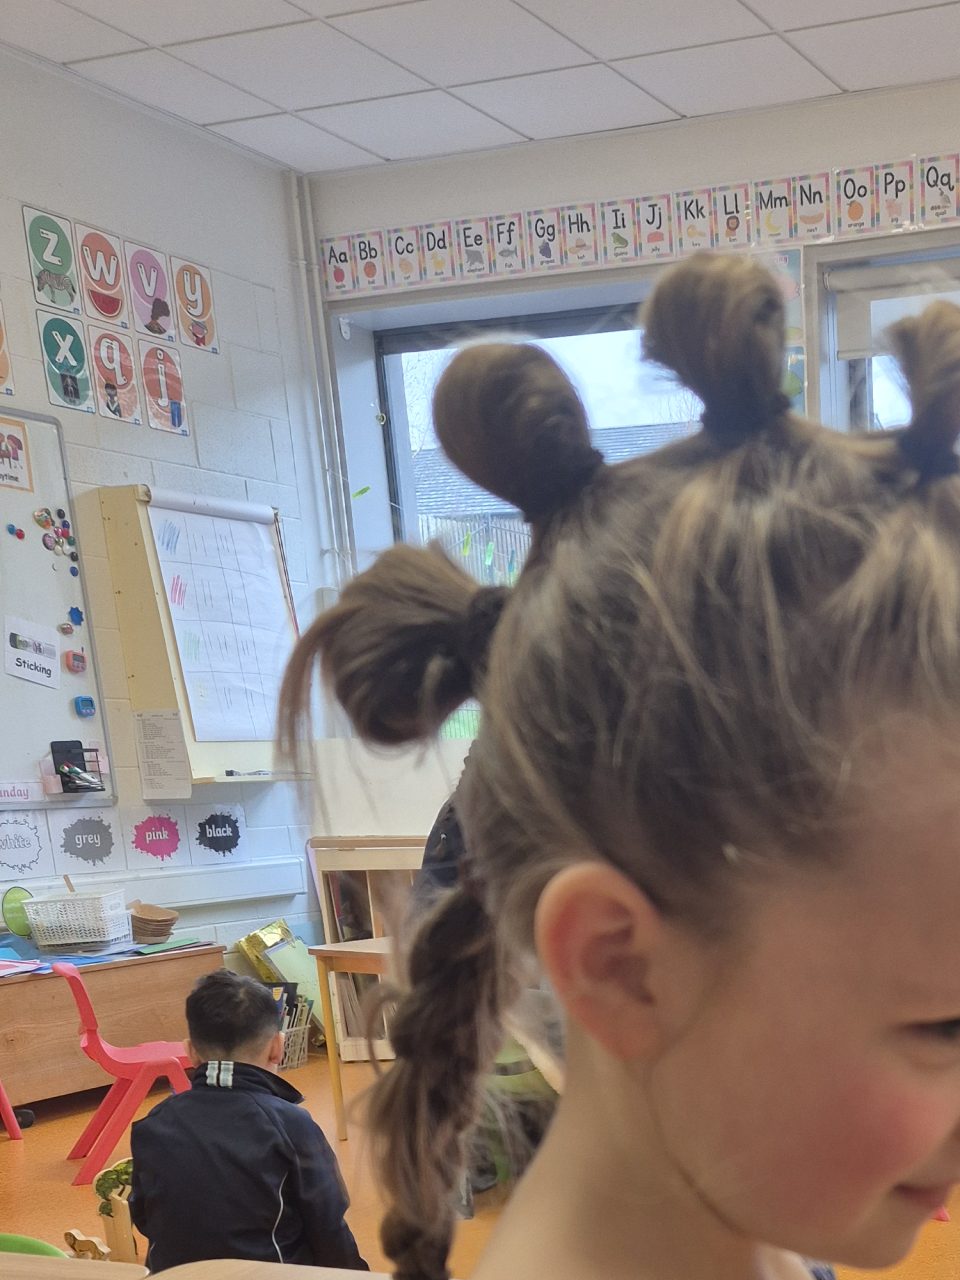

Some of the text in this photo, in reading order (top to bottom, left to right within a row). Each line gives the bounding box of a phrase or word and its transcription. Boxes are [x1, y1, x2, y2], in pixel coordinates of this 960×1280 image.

[844, 178, 867, 199] Oo
[884, 172, 906, 199] Pp
[926, 166, 955, 192] Qq
[723, 193, 740, 215] Ll
[759, 190, 789, 211] Mm
[800, 184, 823, 206] Nn
[612, 209, 626, 230] Ii
[646, 204, 663, 230] Jj
[684, 199, 706, 220] Kk
[496, 221, 516, 245] Ff
[535, 218, 556, 242] Gg
[568, 213, 591, 234] Hh
[40, 228, 62, 266] z
[394, 236, 414, 255] Cc
[426, 230, 447, 251] Dd
[463, 227, 483, 248] Ee
[328, 246, 348, 265] Aa
[359, 241, 377, 261] Bb
[82, 246, 118, 286] w
[137, 263, 158, 298] v
[184, 270, 202, 317] y
[52, 330, 77, 367] x
[100, 339, 128, 386] q
[156, 348, 169, 407] j
[15, 657, 52, 678] Sticking
[75, 832, 101, 848] grey
[146, 827, 169, 842] pink
[206, 823, 232, 839] black
